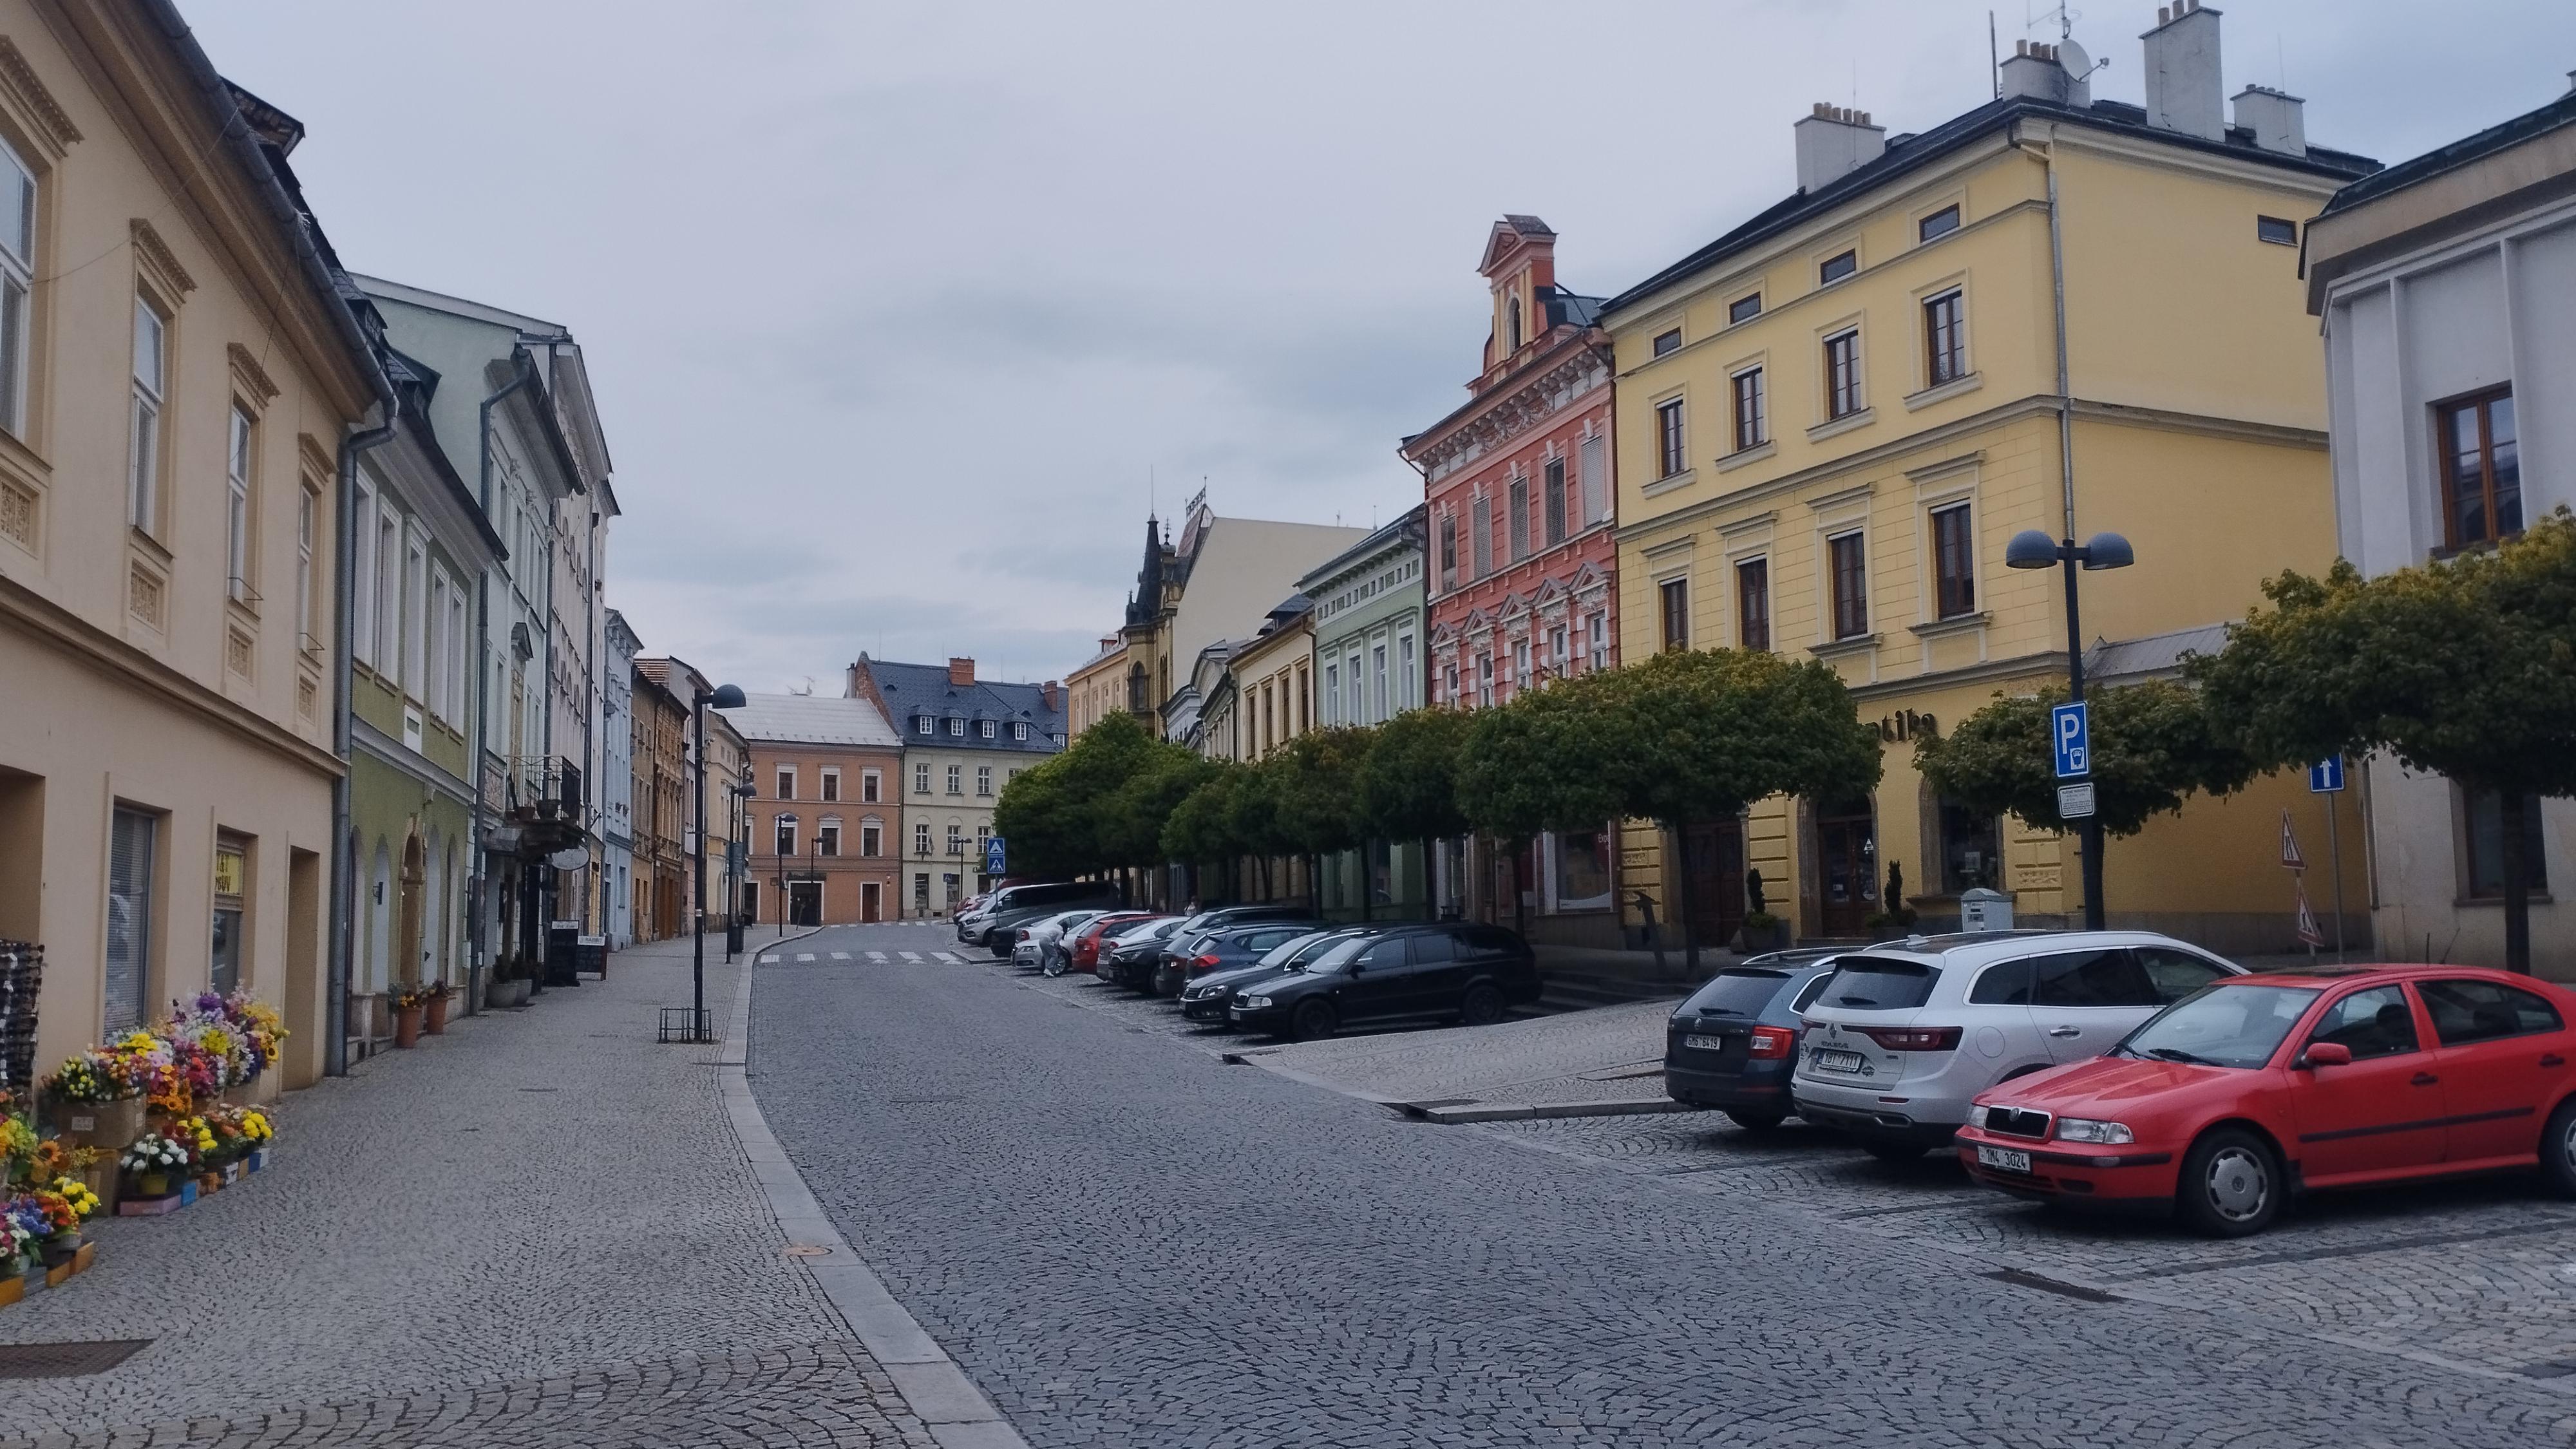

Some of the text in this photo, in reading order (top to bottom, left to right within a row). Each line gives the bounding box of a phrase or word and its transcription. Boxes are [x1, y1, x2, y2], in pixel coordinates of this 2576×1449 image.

[2060, 714, 2079, 754] P
[1840, 1053, 1858, 1068] 7111
[2004, 1152, 2026, 1169] 3024
